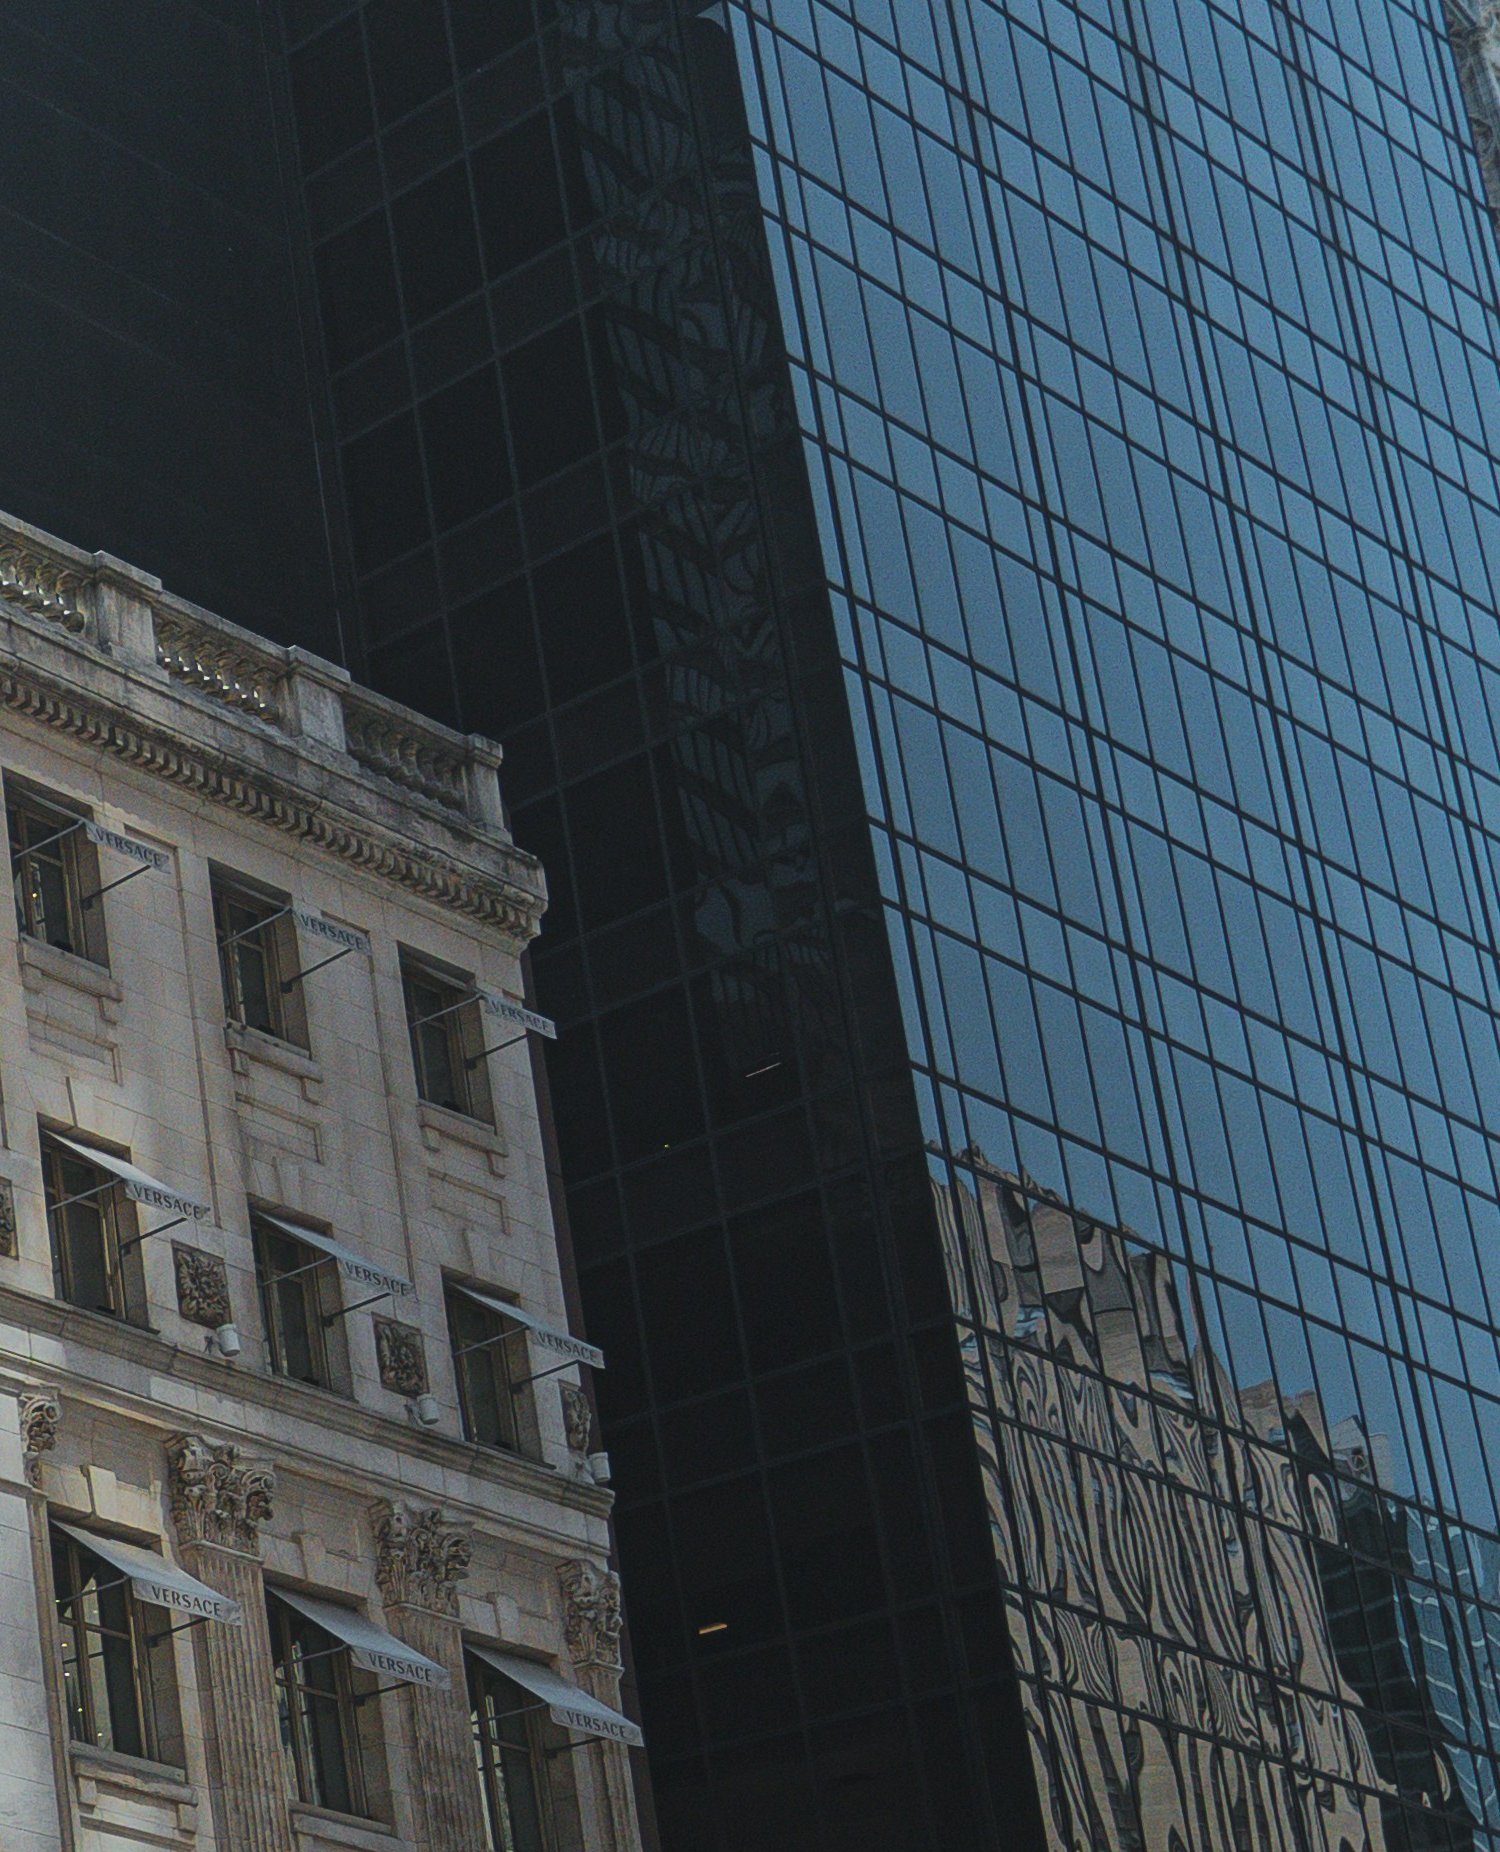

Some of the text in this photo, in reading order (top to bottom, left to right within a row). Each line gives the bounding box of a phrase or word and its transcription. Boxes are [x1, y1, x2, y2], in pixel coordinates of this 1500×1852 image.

[97, 829, 163, 867] VERSACE
[300, 914, 365, 951] VERSACE
[490, 1002, 550, 1032] VERSACE
[133, 1184, 202, 1219] VERSACE
[345, 1261, 410, 1295] VERSACE
[536, 1330, 598, 1363] VERSACE
[151, 1586, 222, 1617] VERSACE
[367, 1653, 433, 1683] VERSACE
[566, 1710, 627, 1739] VERSACE
